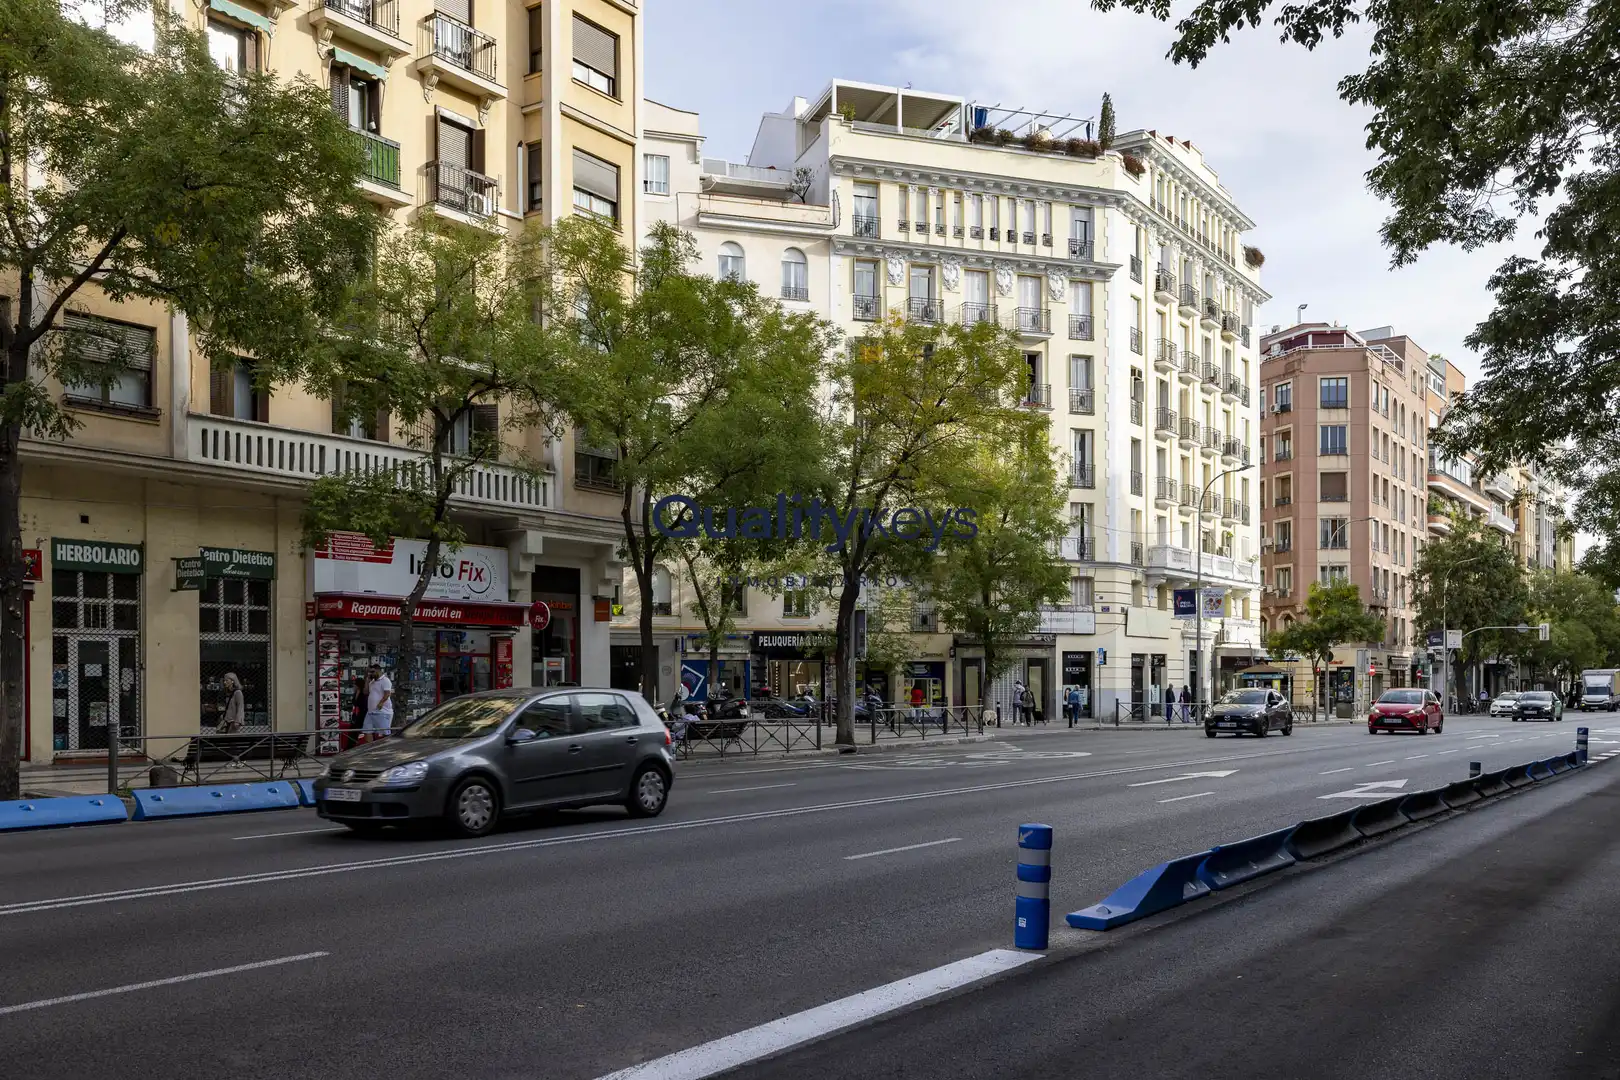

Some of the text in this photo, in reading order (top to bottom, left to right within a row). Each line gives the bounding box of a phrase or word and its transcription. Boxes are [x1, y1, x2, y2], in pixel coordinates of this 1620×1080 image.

[56, 543, 140, 566] HERBOLARIO
[232, 550, 273, 566] Dietético
[179, 559, 202, 569] Centro
[458, 559, 484, 582] Fix
[351, 601, 402, 616] Reparamo
[422, 606, 449, 618] móvil
[450, 609, 462, 619] en
[534, 615, 545, 623] Fix
[758, 633, 804, 647] PELUQUERÍA
